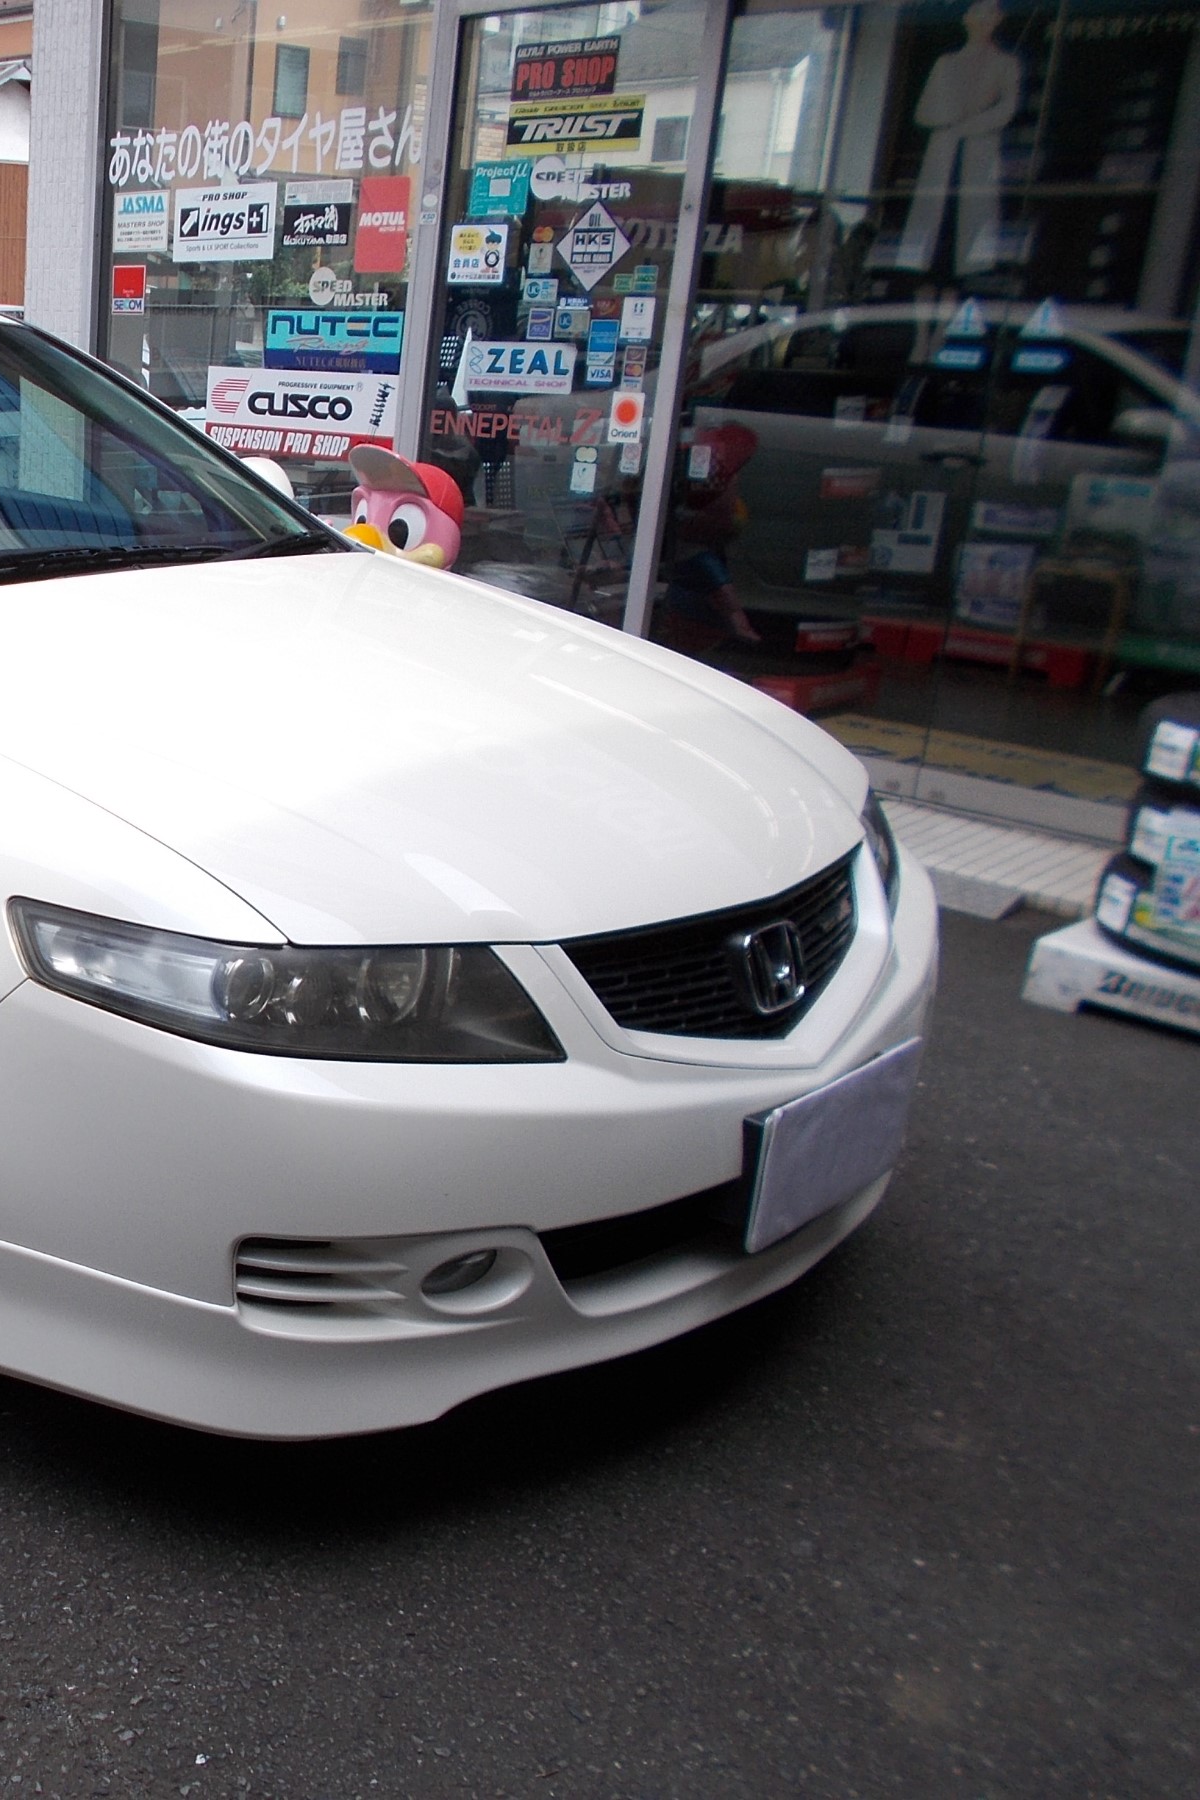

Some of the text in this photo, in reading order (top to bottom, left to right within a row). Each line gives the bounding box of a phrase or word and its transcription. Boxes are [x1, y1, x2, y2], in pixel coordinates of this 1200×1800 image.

[547, 42, 581, 55] POWER
[584, 39, 618, 52] EARTH
[516, 55, 615, 91] PRO SHOP
[513, 112, 639, 141] TRUST
[109, 104, 421, 188] あなたの街のタイヤ屋さん
[202, 191, 248, 202] PRO SHOP
[118, 195, 165, 215] JASMA
[117, 220, 165, 229] MASTERS SHOP
[359, 211, 405, 227] MOTUL
[575, 232, 612, 246] HKS
[453, 258, 480, 269] 会員店
[312, 279, 352, 293] SPEED
[114, 299, 142, 310] SECOM
[333, 293, 389, 307] MASTER
[271, 314, 400, 338] NUTEC
[486, 348, 570, 376] ZEAL
[591, 369, 612, 379] VISA
[278, 381, 355, 391] PROGRESSIVE EQUIPMENT
[469, 378, 568, 388] TECHNICAL SHOP
[248, 391, 353, 422] CUSCO
[430, 408, 569, 443] ENNEPETAL
[610, 428, 638, 439] Orient
[210, 425, 351, 458] SUSPENSION PRO SHOP
